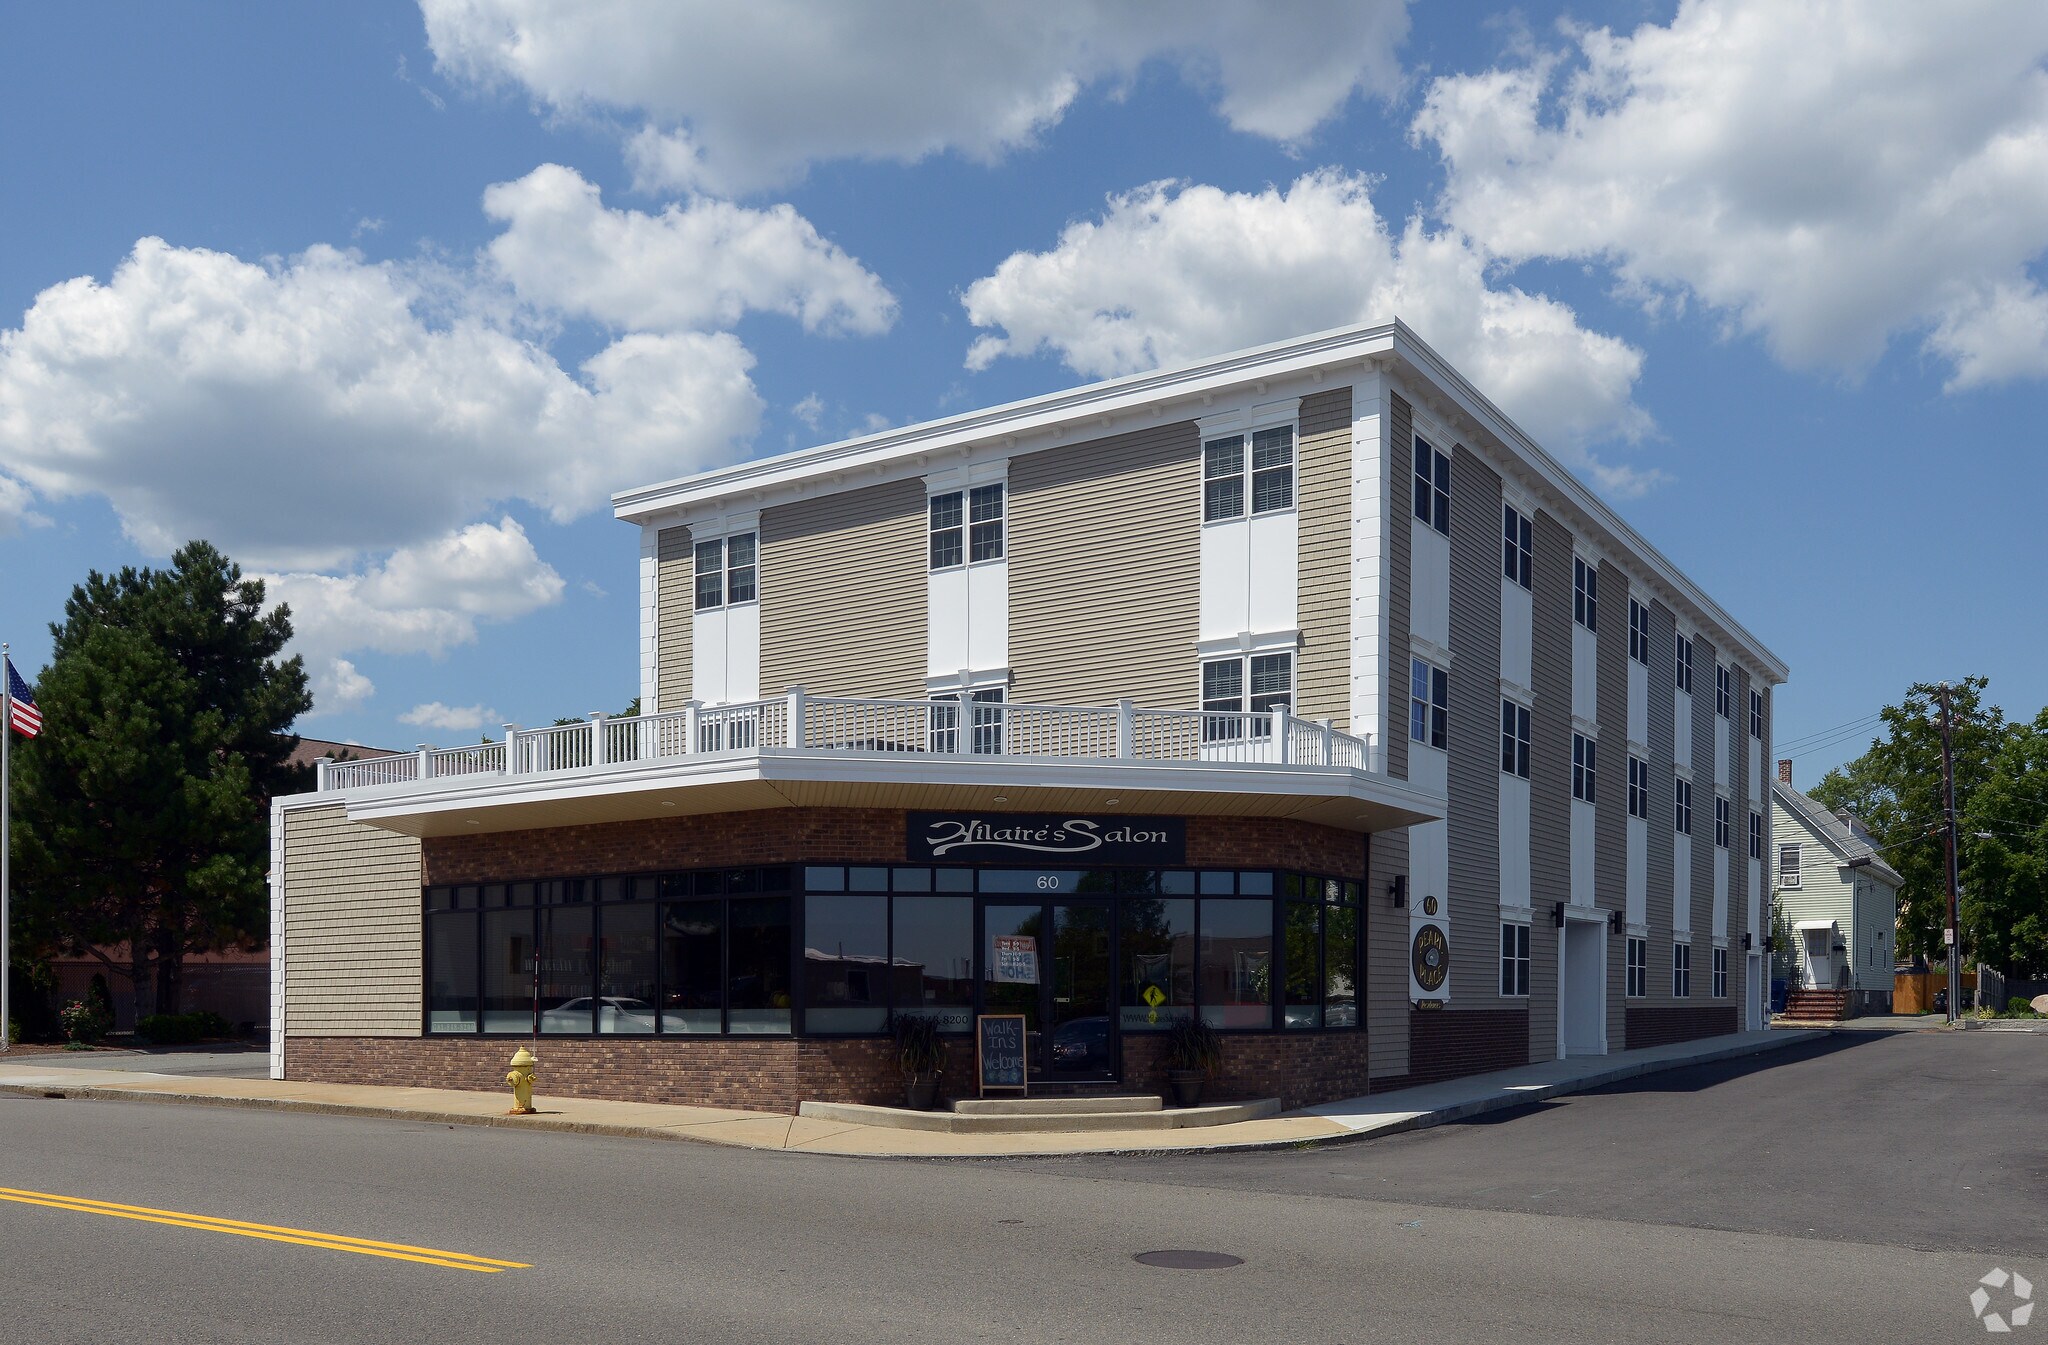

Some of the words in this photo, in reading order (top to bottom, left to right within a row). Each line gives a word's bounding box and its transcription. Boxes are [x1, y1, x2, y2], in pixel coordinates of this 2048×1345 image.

[1062, 819, 1168, 853] Salon
[1036, 875, 1059, 889] 60
[1427, 898, 1436, 913] 60
[1419, 964, 1442, 985] PLACE
[989, 1036, 1017, 1049] Ins
[982, 1051, 1024, 1070] Welcome
